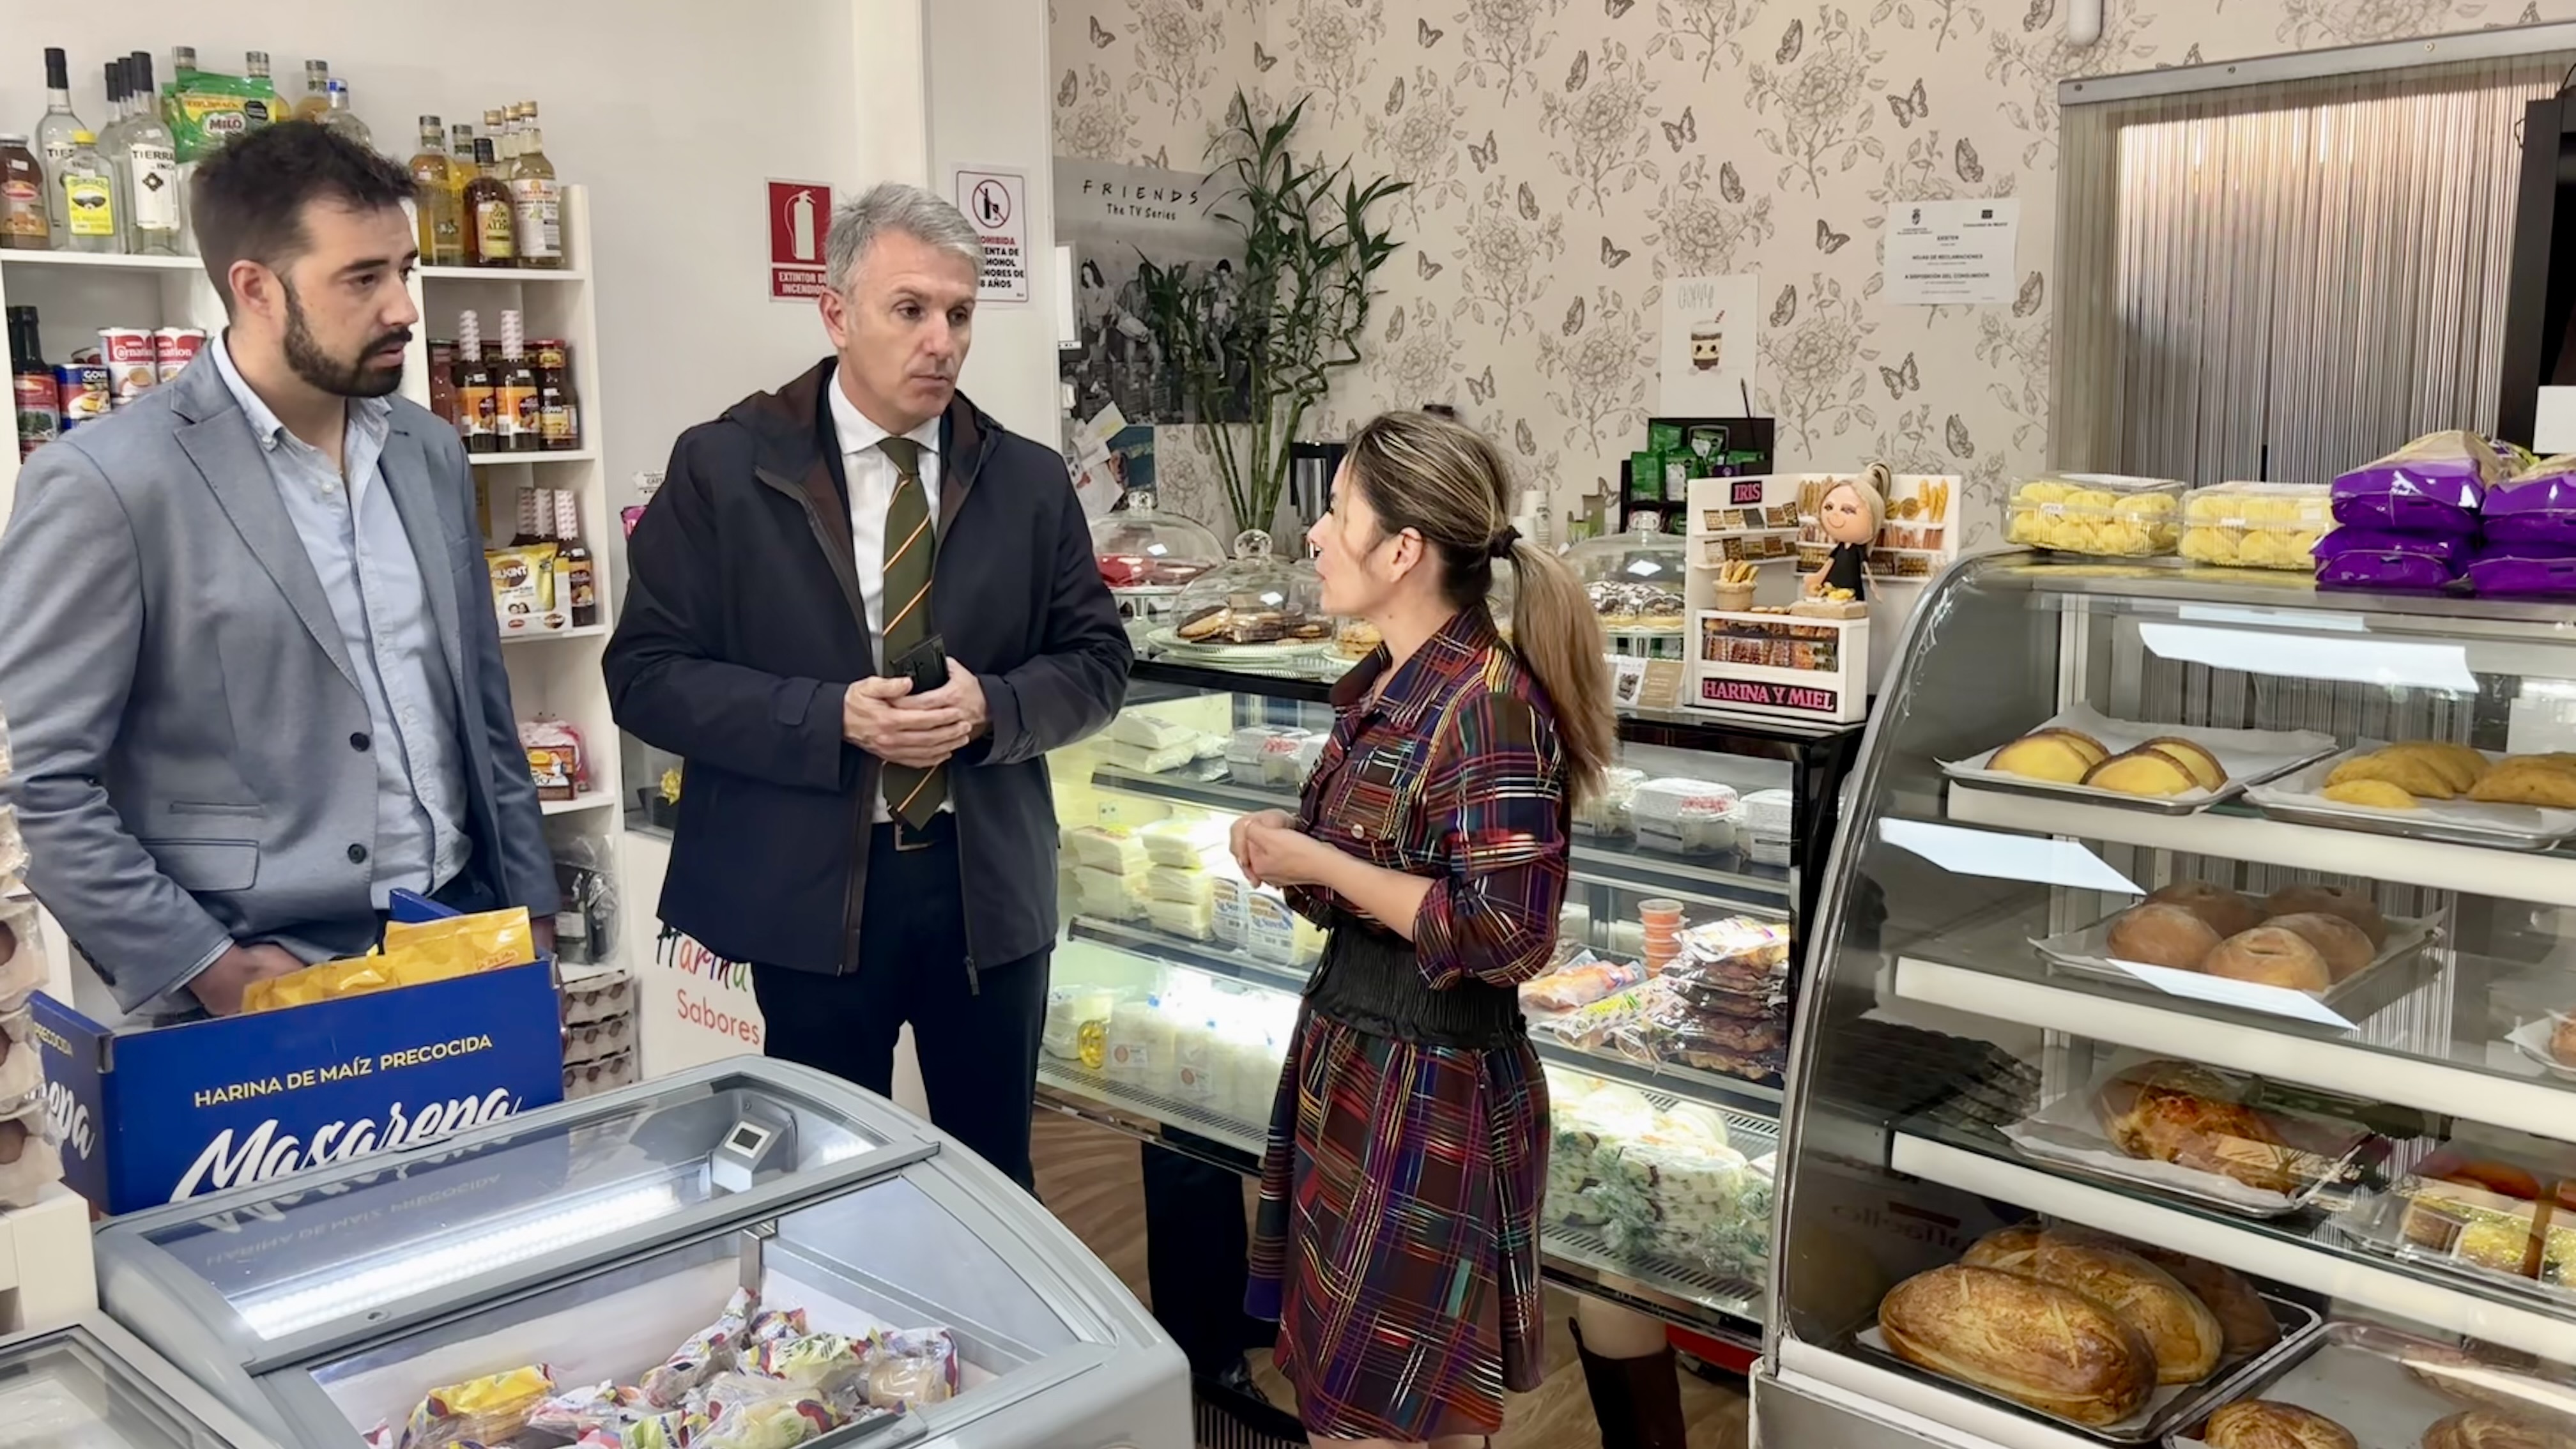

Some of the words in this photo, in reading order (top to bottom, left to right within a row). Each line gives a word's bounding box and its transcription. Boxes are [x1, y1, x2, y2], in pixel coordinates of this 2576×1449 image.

[210, 119, 242, 130] MILO
[1082, 180, 1199, 205] FRIENDS
[1107, 203, 1124, 215] The
[1129, 205, 1142, 217] TV
[1145, 207, 1177, 221] Series
[981, 236, 1016, 245] OHIBIDA
[985, 247, 1006, 256] ENTA
[1009, 248, 1019, 256] DE
[779, 272, 816, 284] EXTINTOR
[1013, 270, 1024, 278] DE
[988, 277, 1012, 288] AÑOS
[1733, 483, 1762, 502] IRIS
[1703, 680, 1770, 703] HARINA
[1773, 686, 1786, 705] Y
[1788, 690, 1834, 711] MIEL
[677, 988, 760, 1045] Sabores
[194, 1076, 283, 1108] HARINA
[287, 1070, 316, 1091] DE
[320, 1055, 372, 1084] MAÍZ
[379, 1033, 493, 1071] PRECOCIDA
